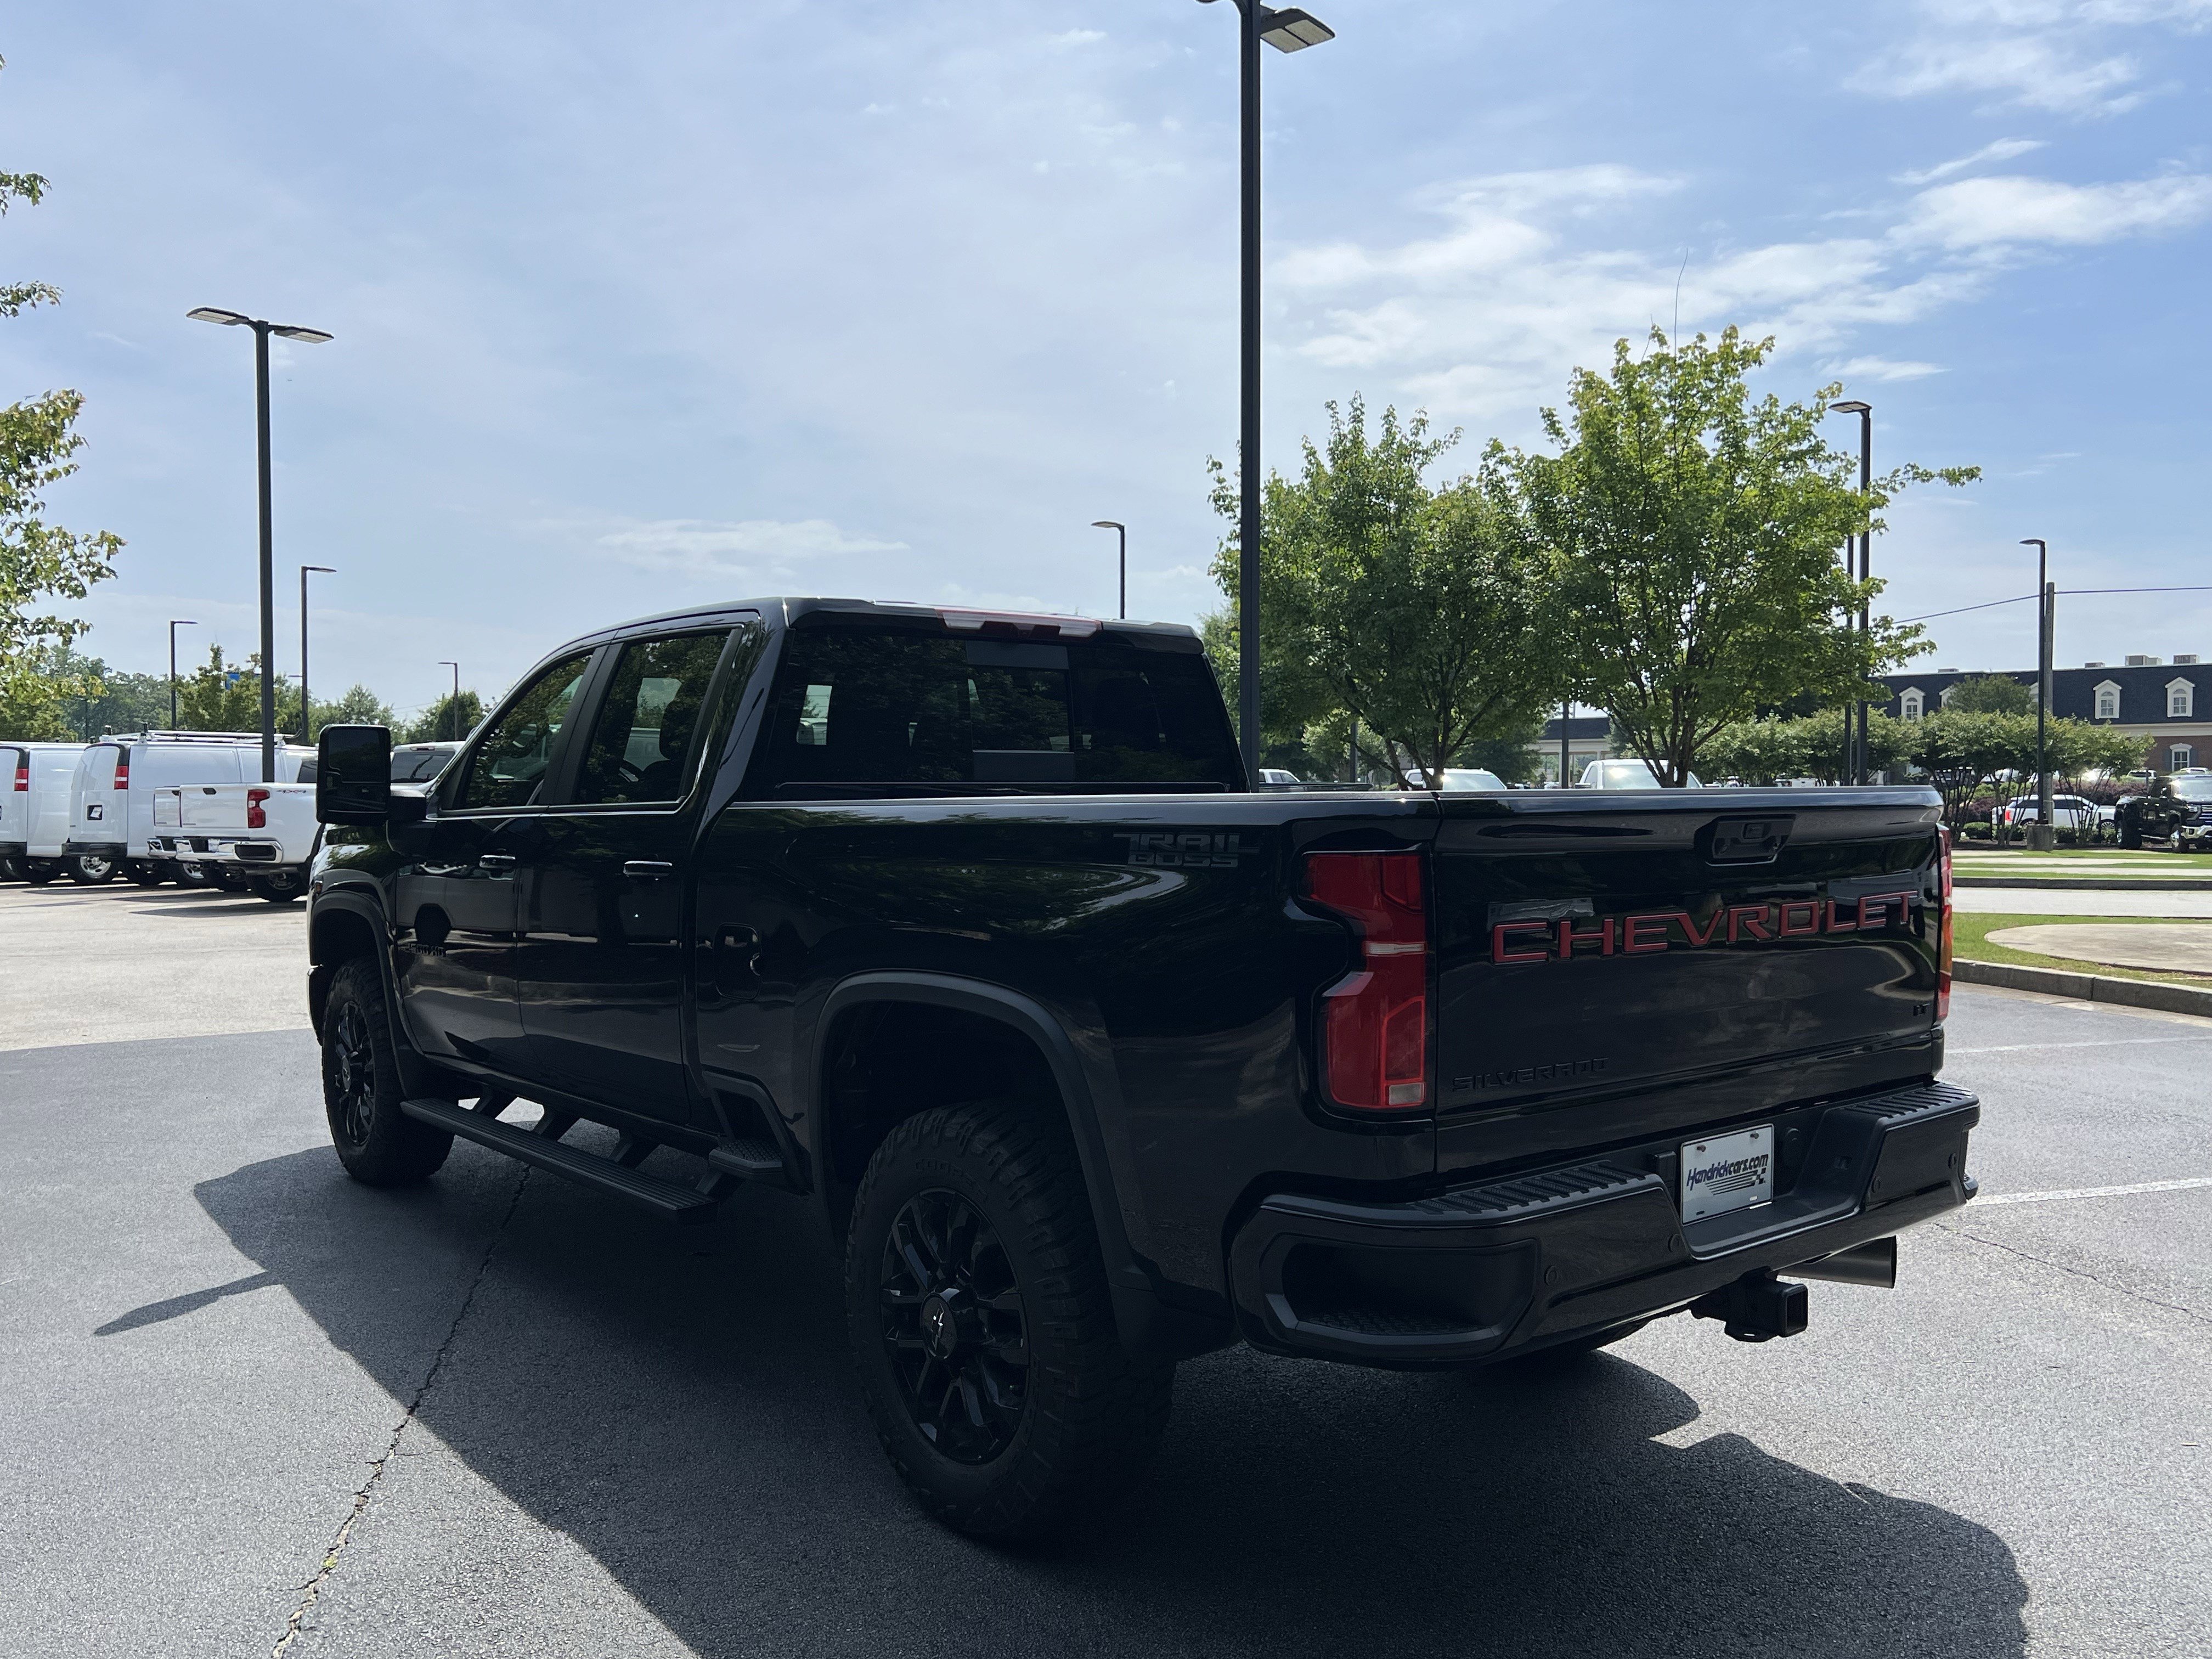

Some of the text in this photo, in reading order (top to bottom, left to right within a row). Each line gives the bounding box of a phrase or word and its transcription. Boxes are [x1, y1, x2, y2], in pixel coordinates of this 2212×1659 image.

[1113, 833, 1260, 853] TRAIL
[1127, 852, 1239, 867] BOSS
[1492, 890, 1918, 963] CHEVROLET
[1453, 1057, 1609, 1091] SILVERADO
[1686, 1154, 1769, 1191] Hendrickcars.com
